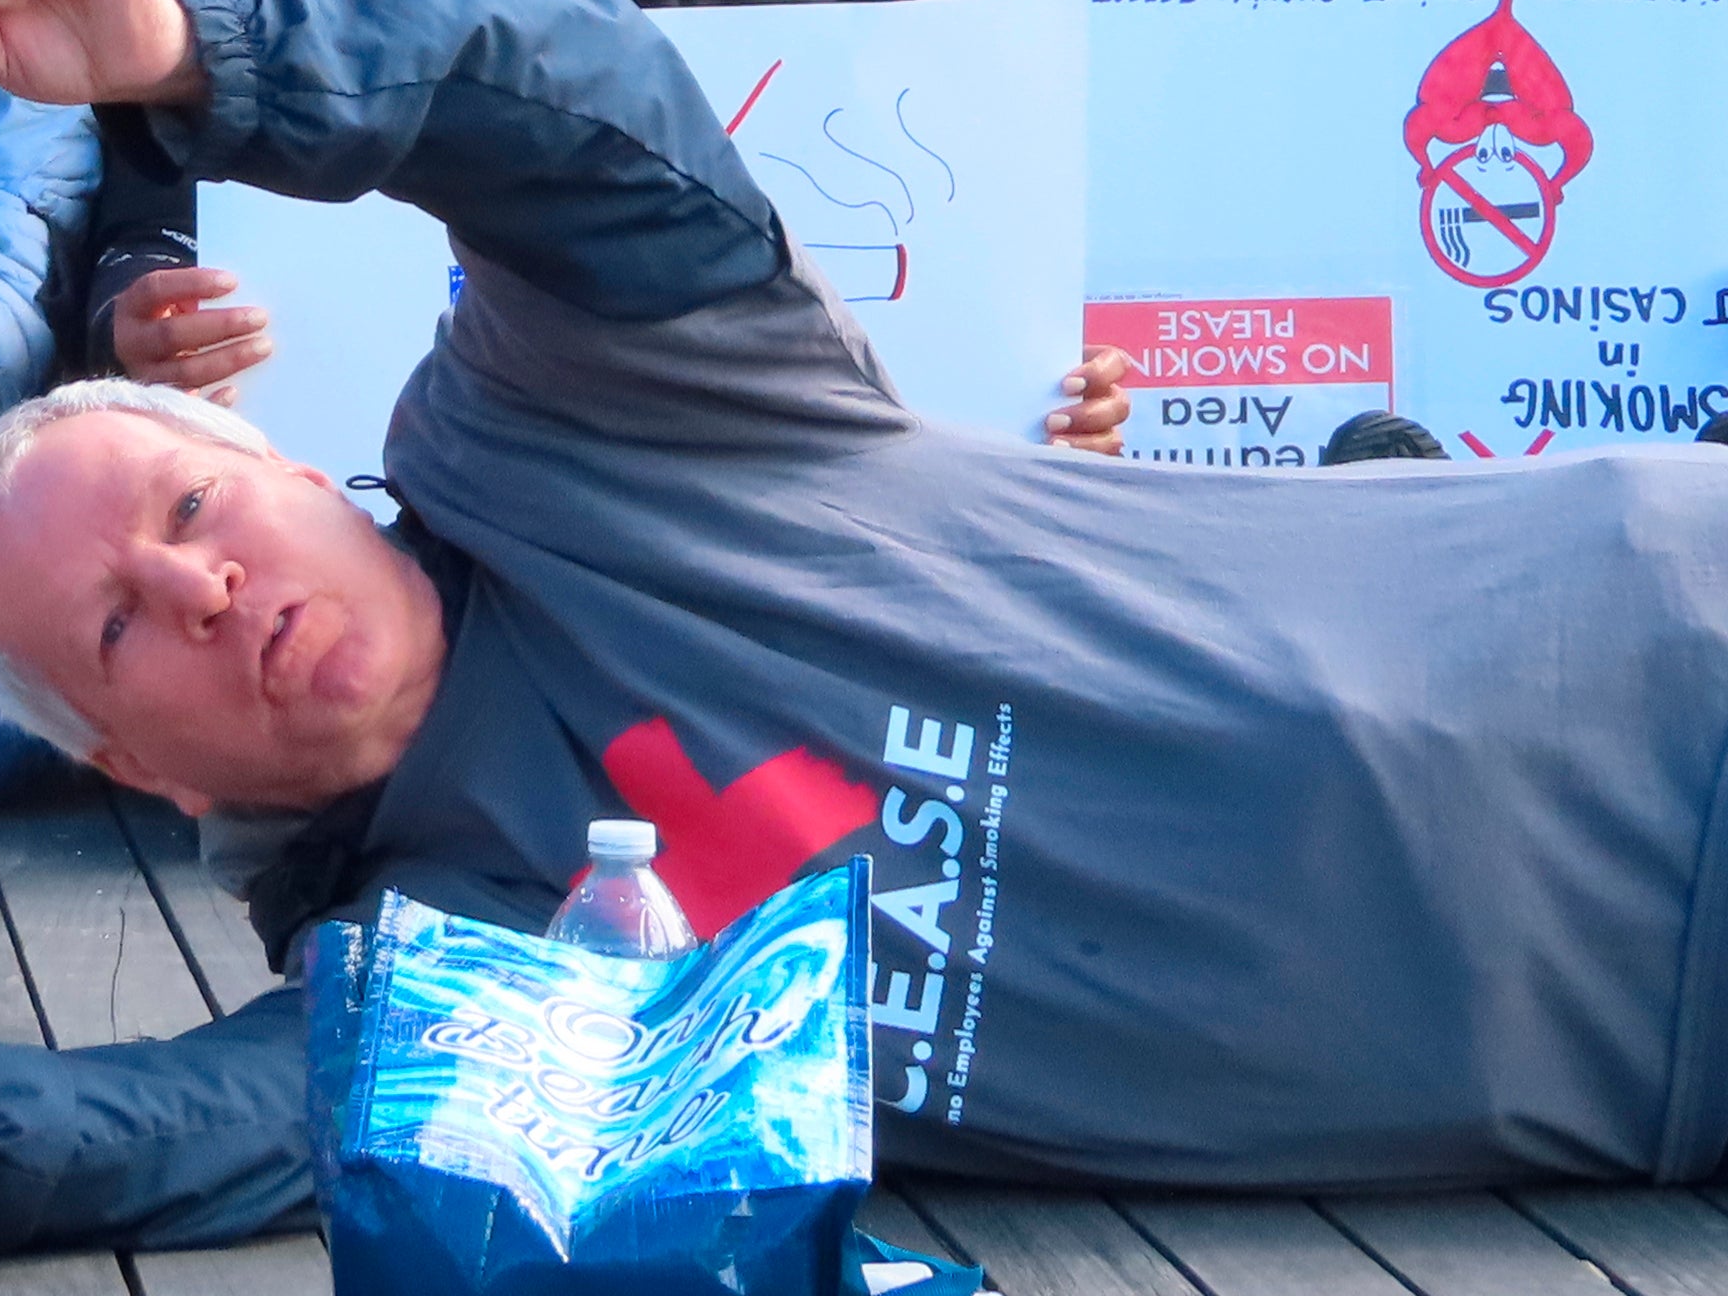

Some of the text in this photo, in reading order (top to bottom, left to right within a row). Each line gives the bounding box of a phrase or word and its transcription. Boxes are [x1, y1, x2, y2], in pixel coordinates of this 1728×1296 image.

[1158, 308, 1295, 340] PLEASE
[1118, 343, 1370, 377] SMOKIN NO
[1598, 341, 1640, 378] in
[1161, 396, 1293, 438] Area
[987, 702, 1013, 777] Effects
[979, 784, 1009, 871] Smoking
[968, 877, 999, 965] Against
[947, 972, 984, 1090] Employees
